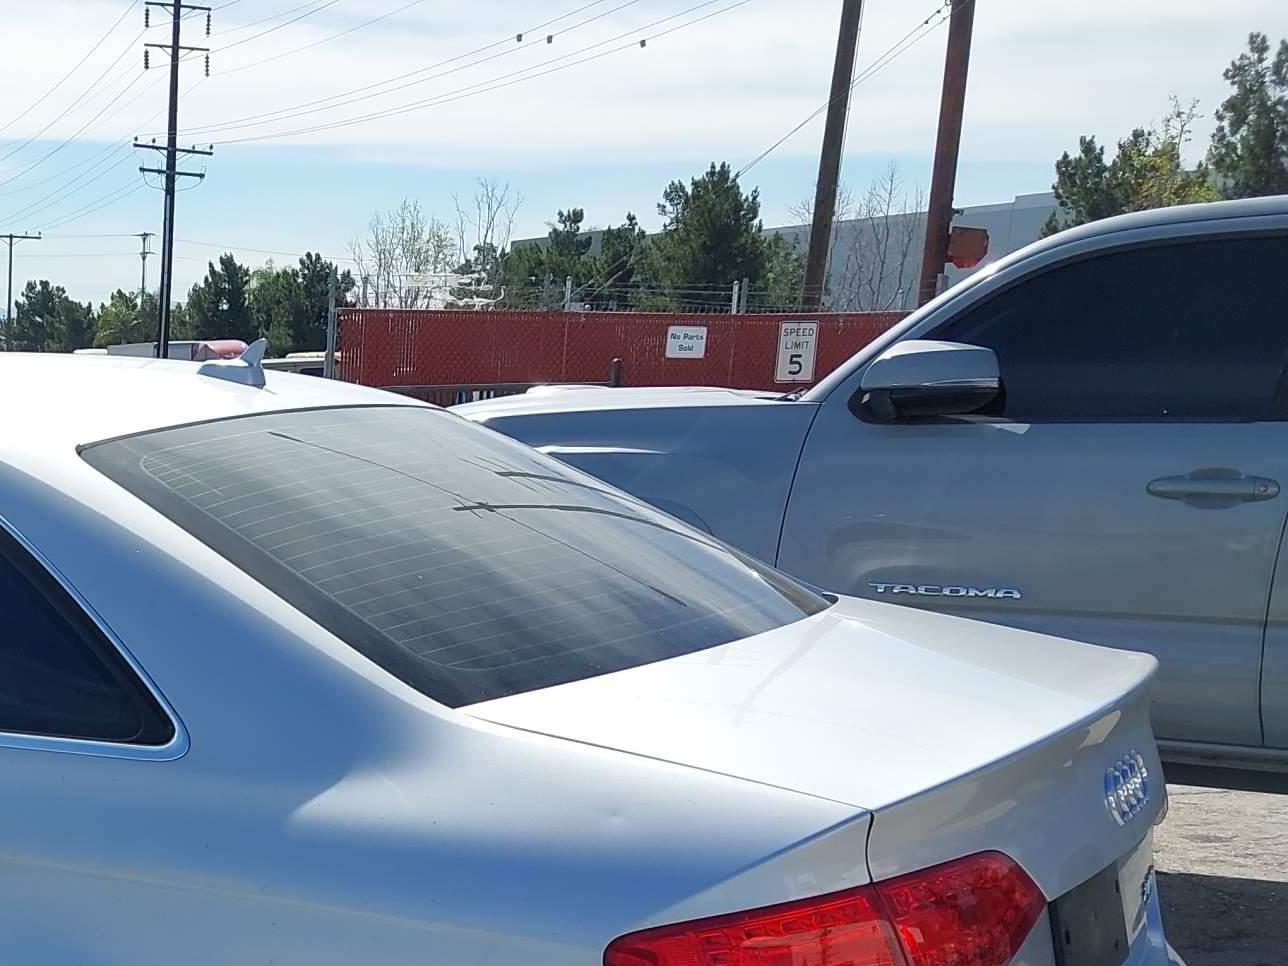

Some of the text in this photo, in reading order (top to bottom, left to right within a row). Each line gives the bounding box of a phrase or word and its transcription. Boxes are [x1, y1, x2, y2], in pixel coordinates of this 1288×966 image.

[670, 332, 704, 342] No Parts
[783, 327, 815, 337] SPEED
[678, 344, 695, 353] Sold
[785, 340, 810, 350] LIMIT
[788, 354, 804, 376] 5
[867, 582, 1023, 599] TACOMA
